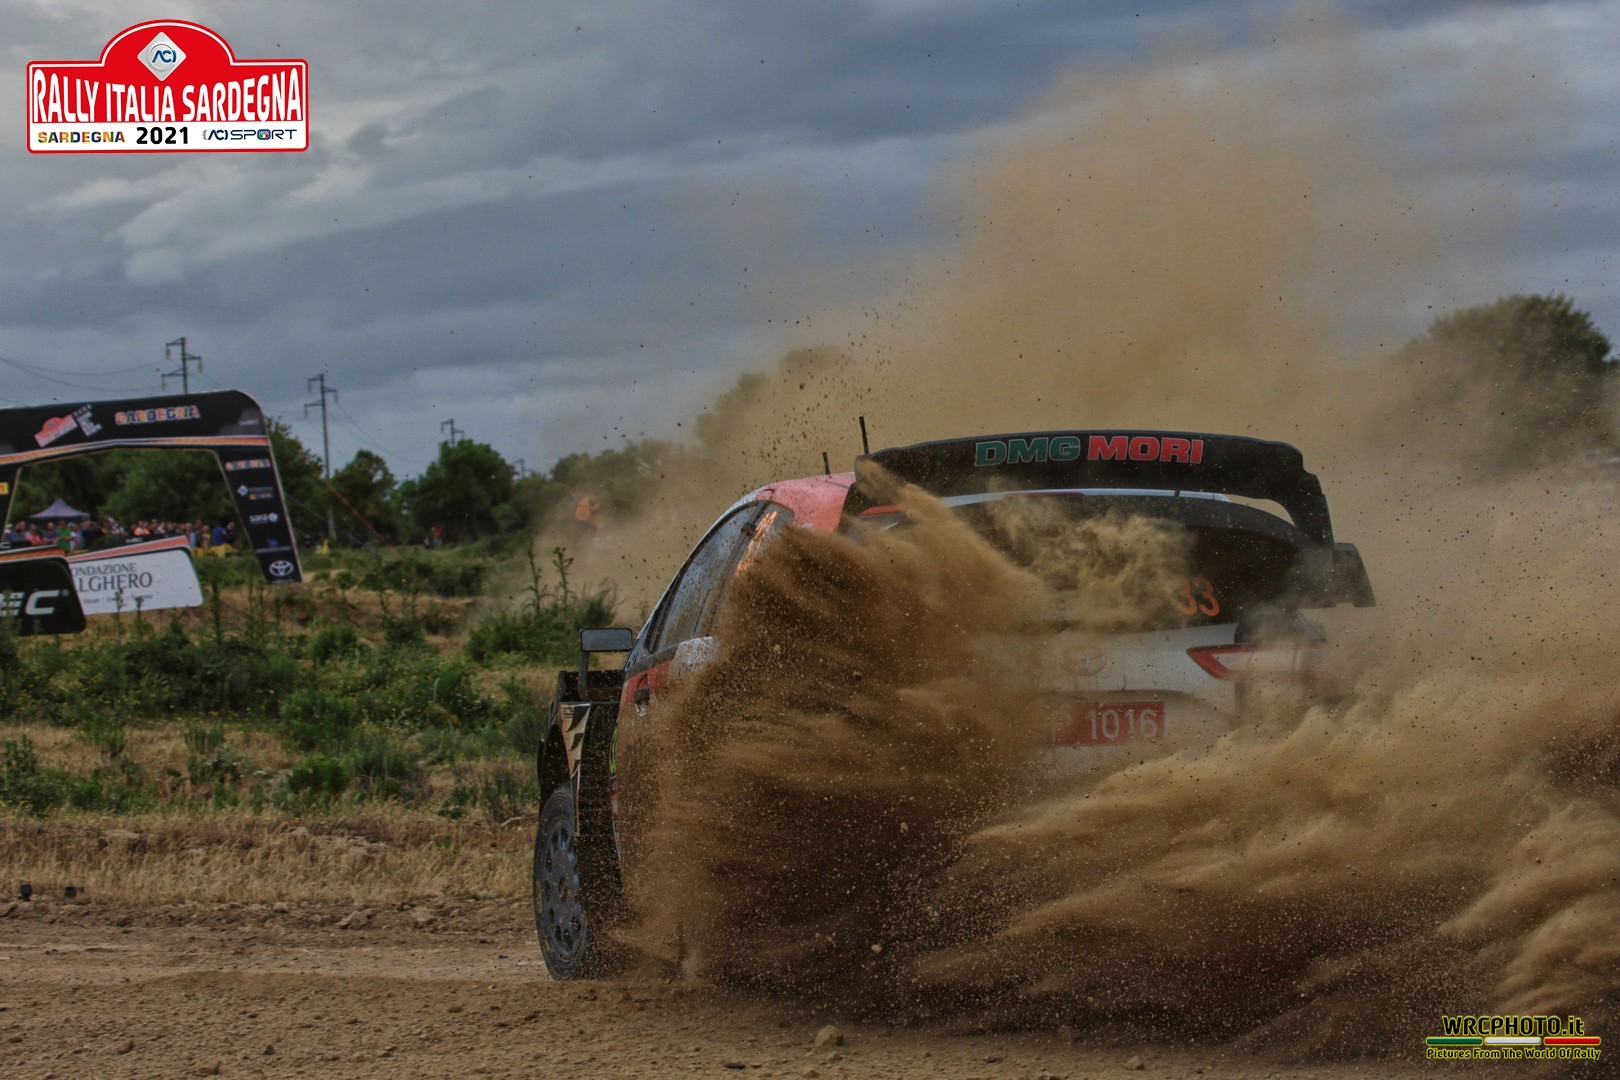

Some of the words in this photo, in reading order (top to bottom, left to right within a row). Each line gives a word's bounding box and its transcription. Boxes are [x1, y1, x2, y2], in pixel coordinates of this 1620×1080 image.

[974, 436, 1081, 468] DMG
[1086, 436, 1205, 465] MORI
[71, 563, 137, 577] ONDAZIONE
[78, 572, 153, 593] LGHERO
[1166, 572, 1220, 617] 33
[1088, 708, 1158, 740] 1016
